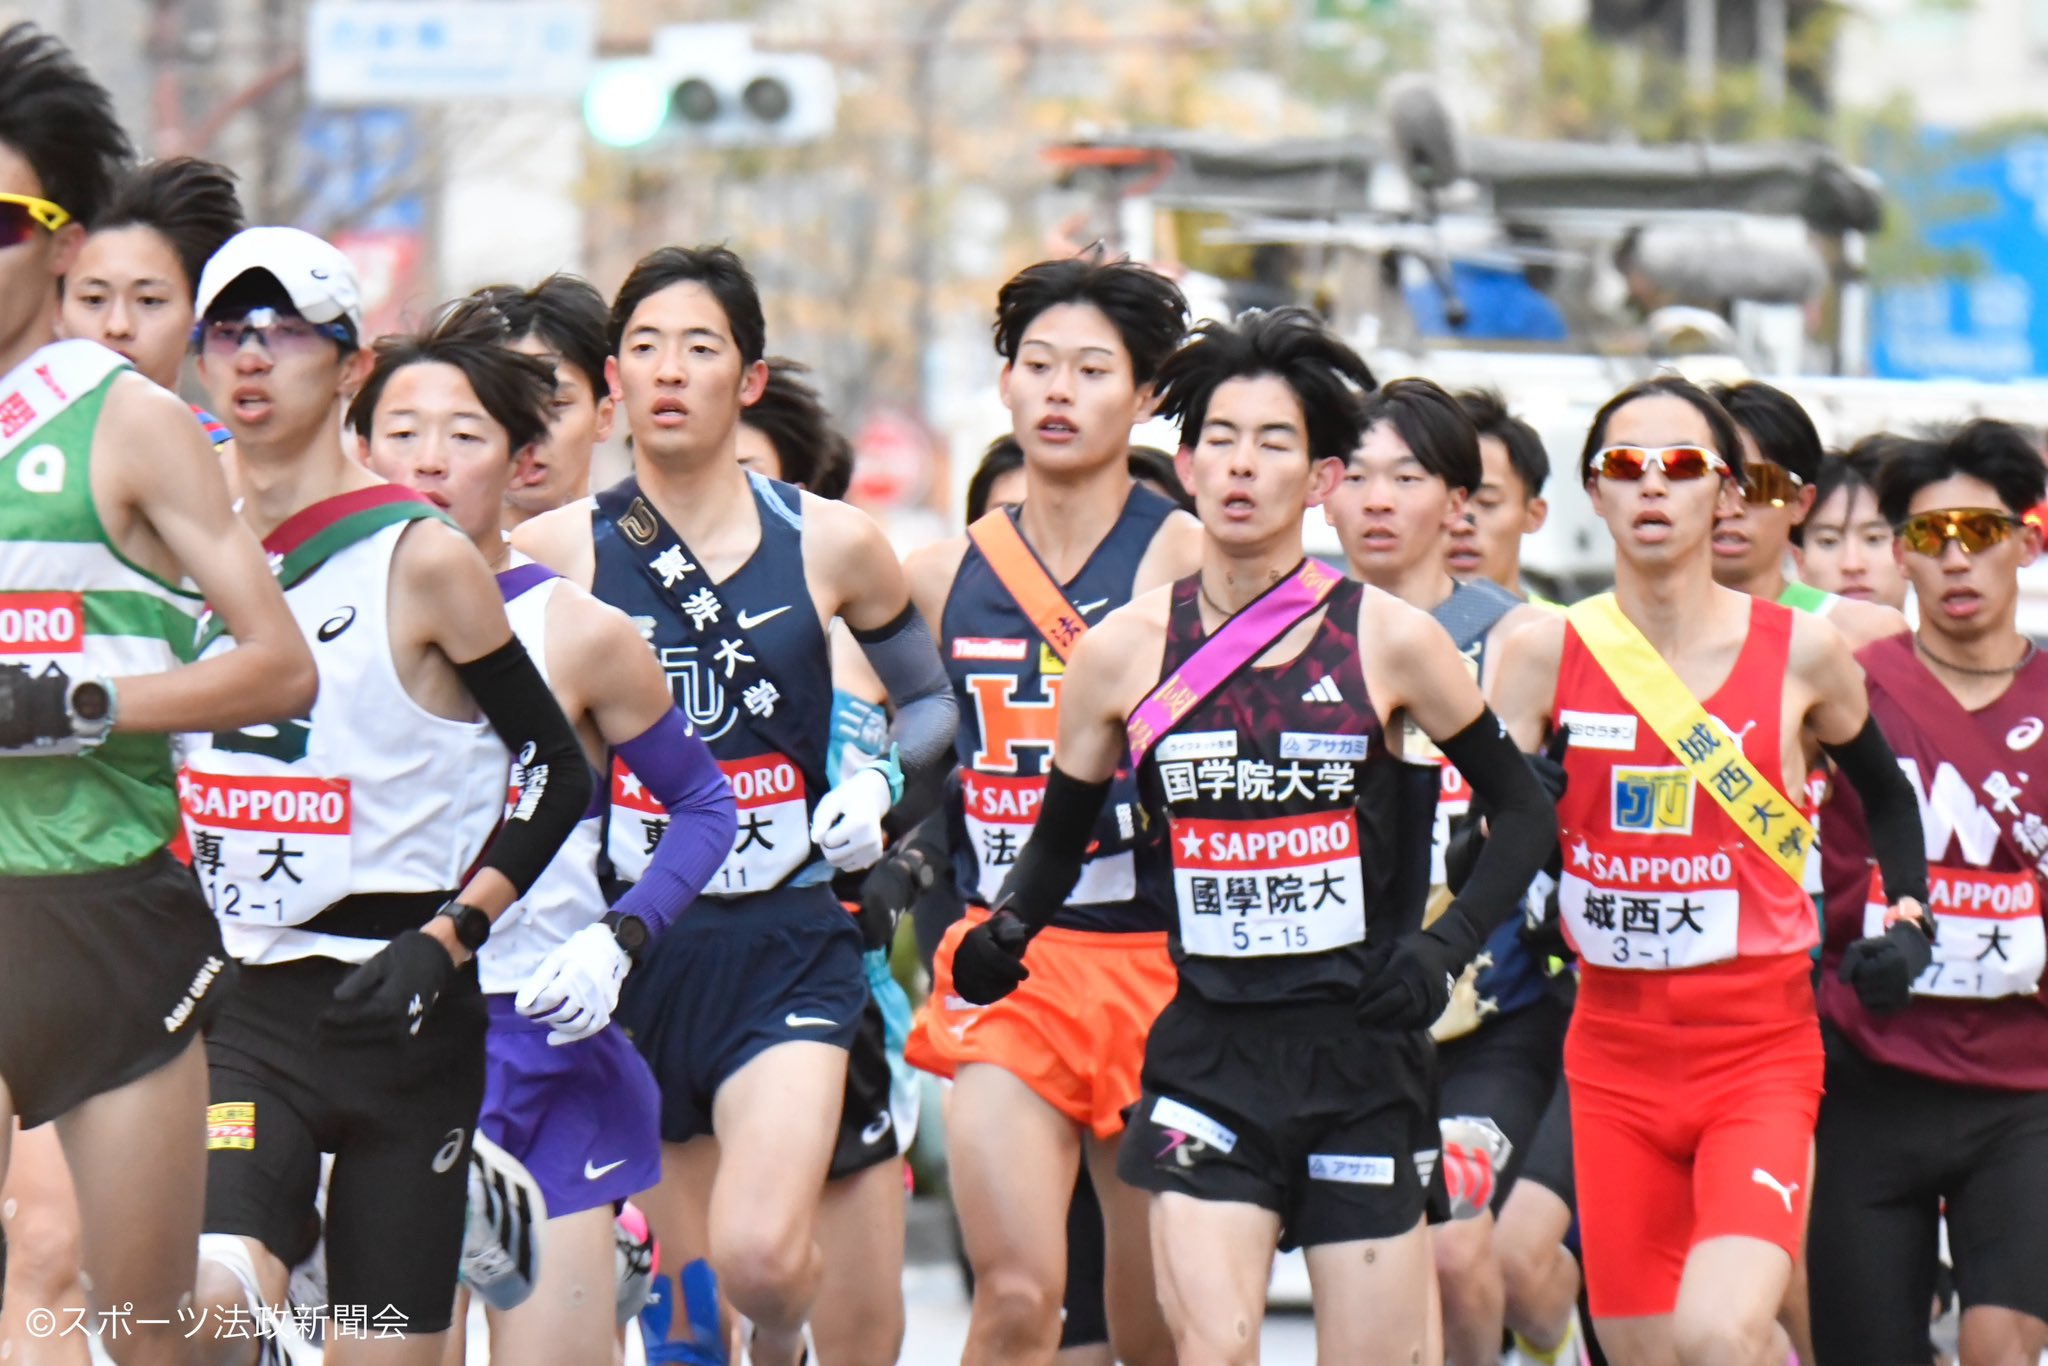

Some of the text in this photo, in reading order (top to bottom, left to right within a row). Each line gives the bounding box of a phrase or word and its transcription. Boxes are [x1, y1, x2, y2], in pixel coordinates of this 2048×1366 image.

[649, 543, 781, 719] 東洋大学
[1307, 739, 1366, 754] アサガミ
[1160, 758, 1355, 803] 国学院大学
[189, 782, 345, 824] SAPPORO
[1209, 821, 1350, 862] SAPPORO
[1592, 852, 1732, 885] SAPPORO
[208, 882, 283, 921] 12-1
[1191, 868, 1347, 915] 國學院大
[1584, 889, 1705, 935] 城西大
[1232, 922, 1308, 950] 5-15
[1612, 936, 1669, 967] 3-1
